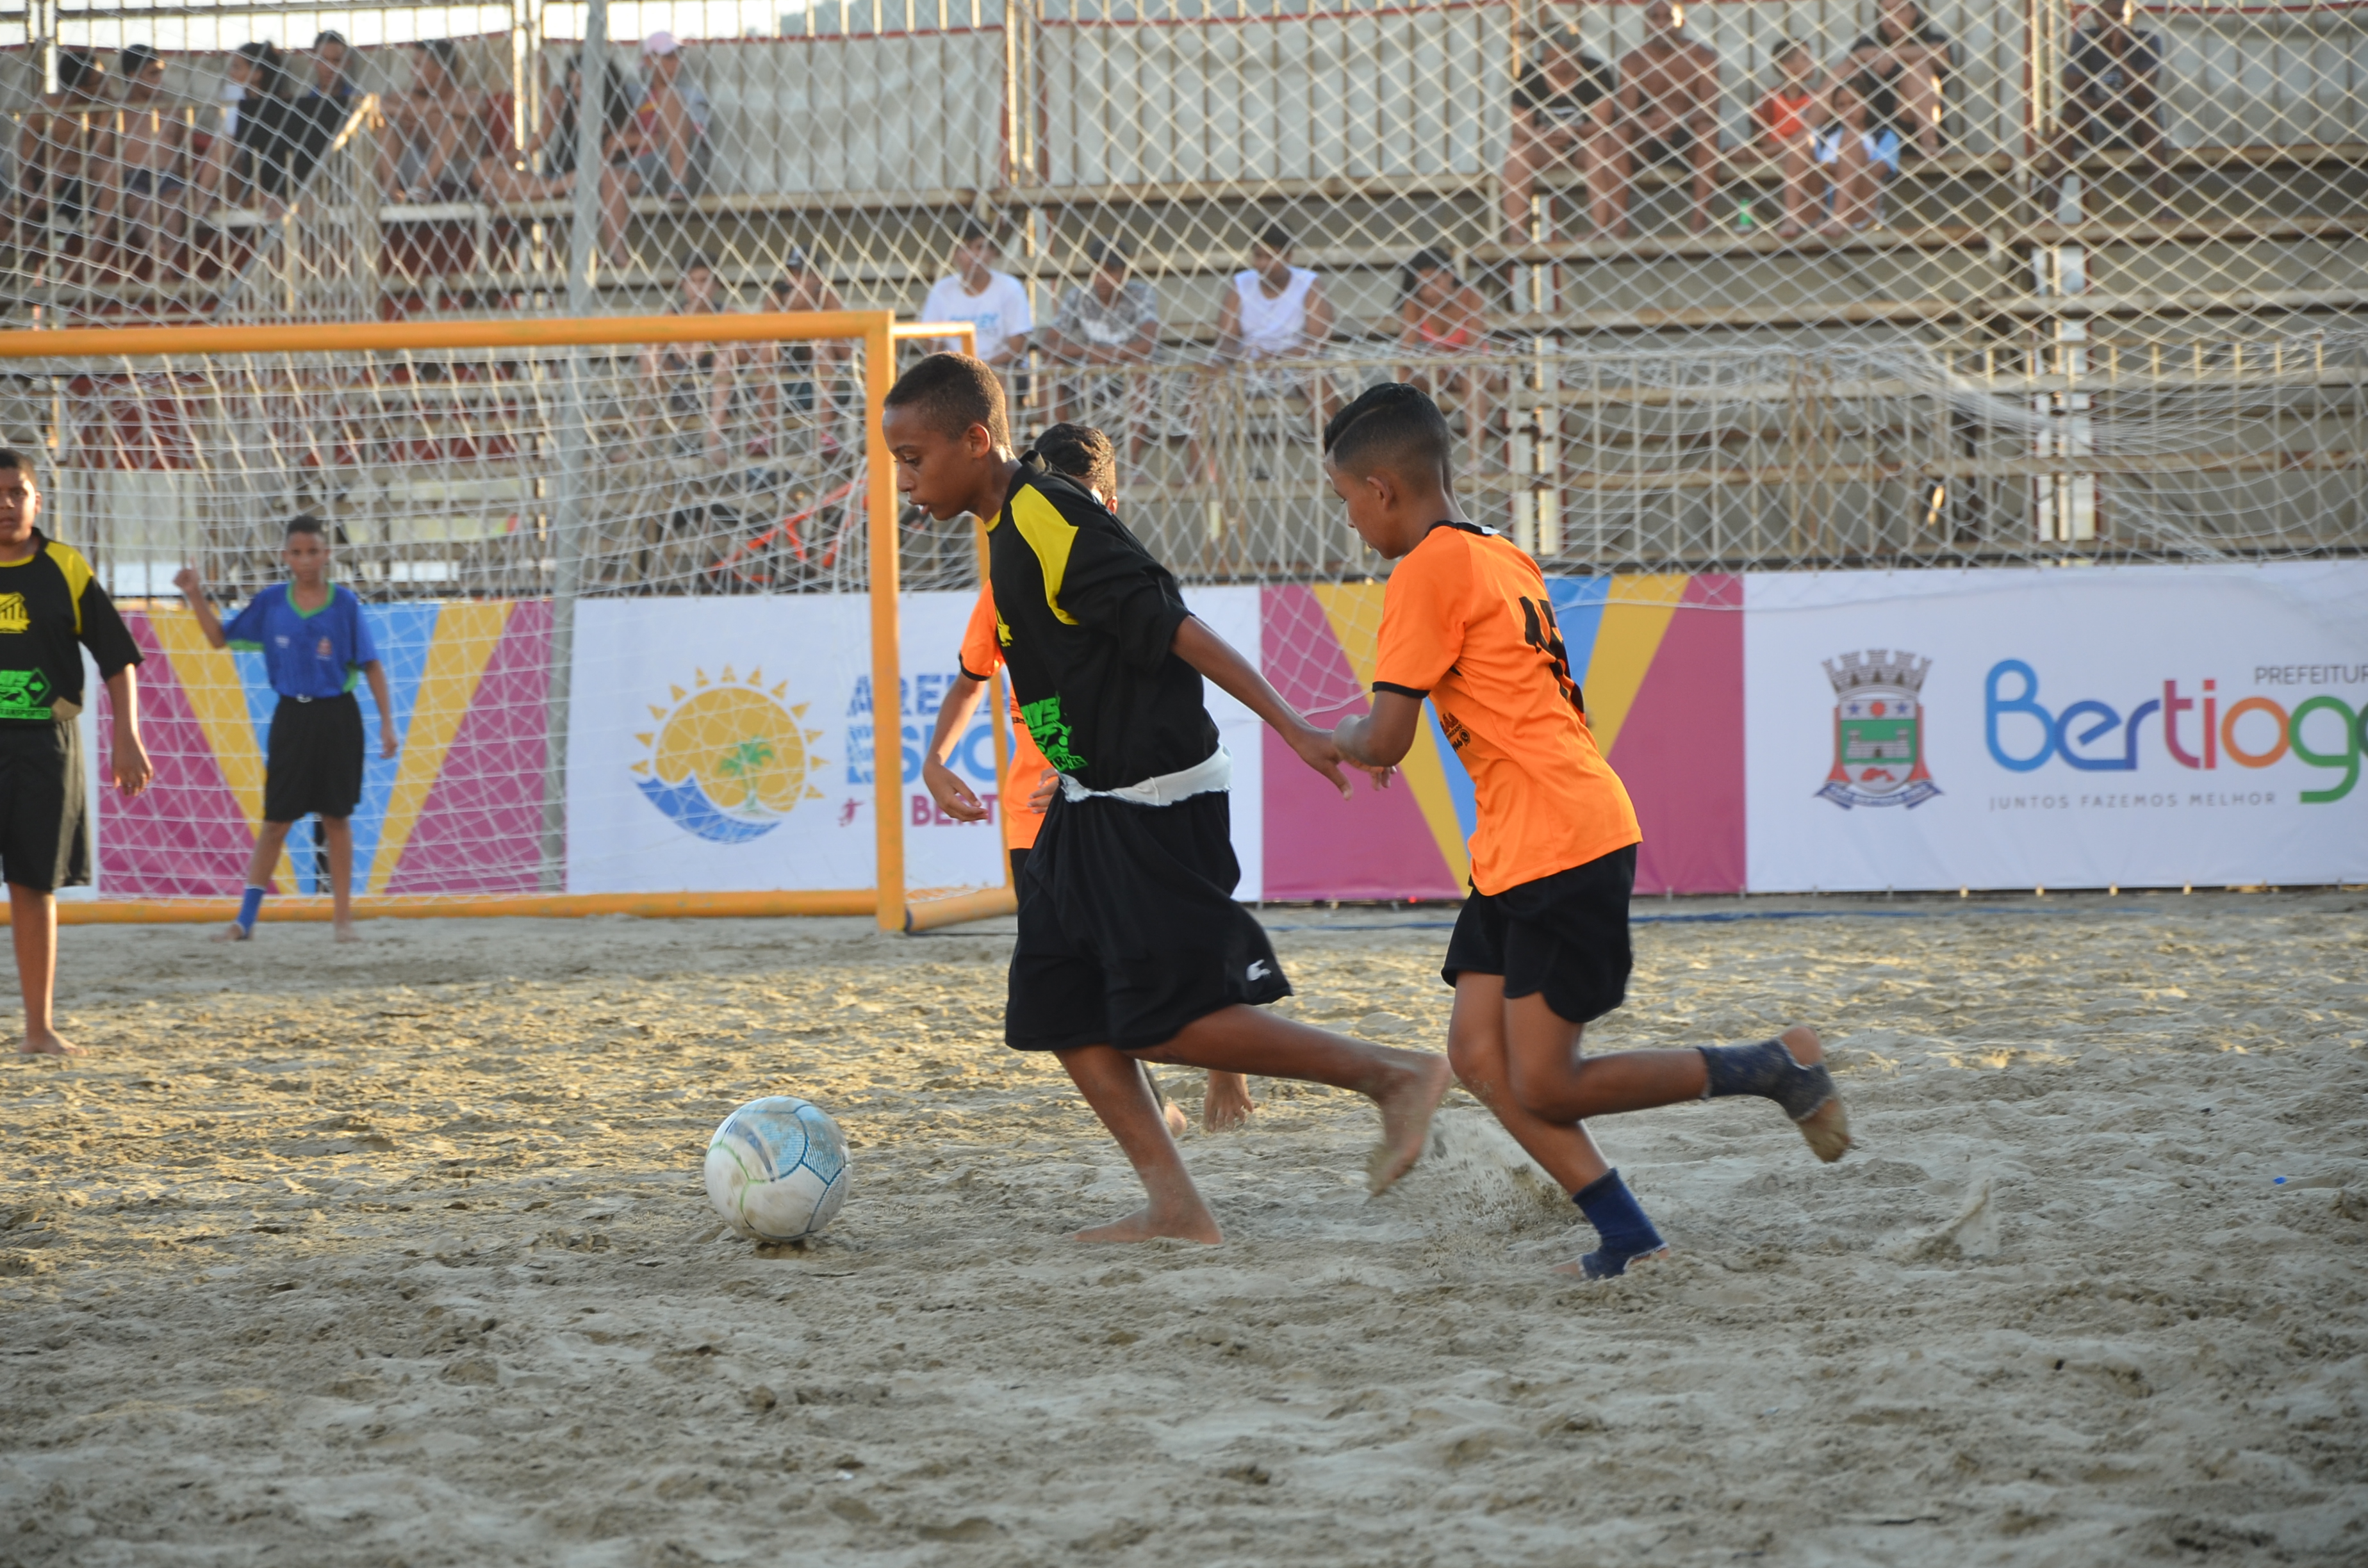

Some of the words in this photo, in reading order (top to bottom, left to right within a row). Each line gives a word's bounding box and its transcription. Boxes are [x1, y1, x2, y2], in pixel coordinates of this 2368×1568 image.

[1985, 658, 2368, 804] Bertiog
[1989, 796, 2069, 812] JUNTOS
[2080, 794, 2178, 808] FAZEMOS
[2189, 792, 2276, 806] MELHOR
